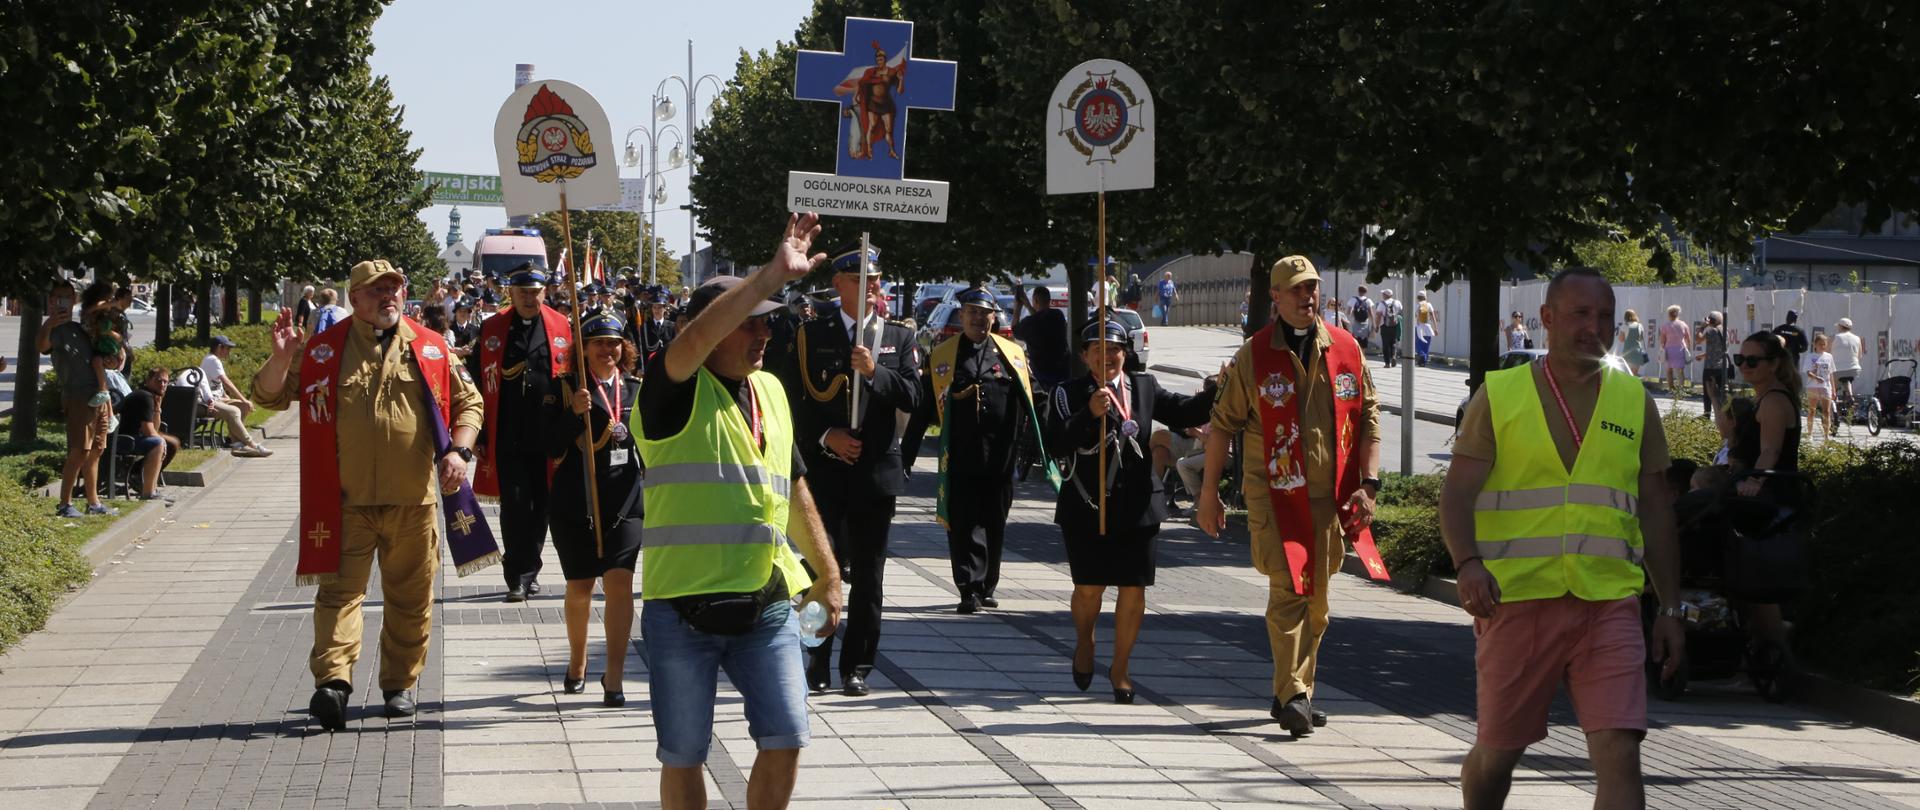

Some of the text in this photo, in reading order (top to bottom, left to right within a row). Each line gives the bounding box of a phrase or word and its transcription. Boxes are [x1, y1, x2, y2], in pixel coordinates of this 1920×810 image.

[432, 189, 504, 203] estiwal muzy
[803, 179, 932, 198] OGÓLNOPOLSKA PIESZA
[794, 196, 940, 216] PIELGRZYMKA STRAŻAKÓW
[1600, 420, 1636, 441] STRAŻ
